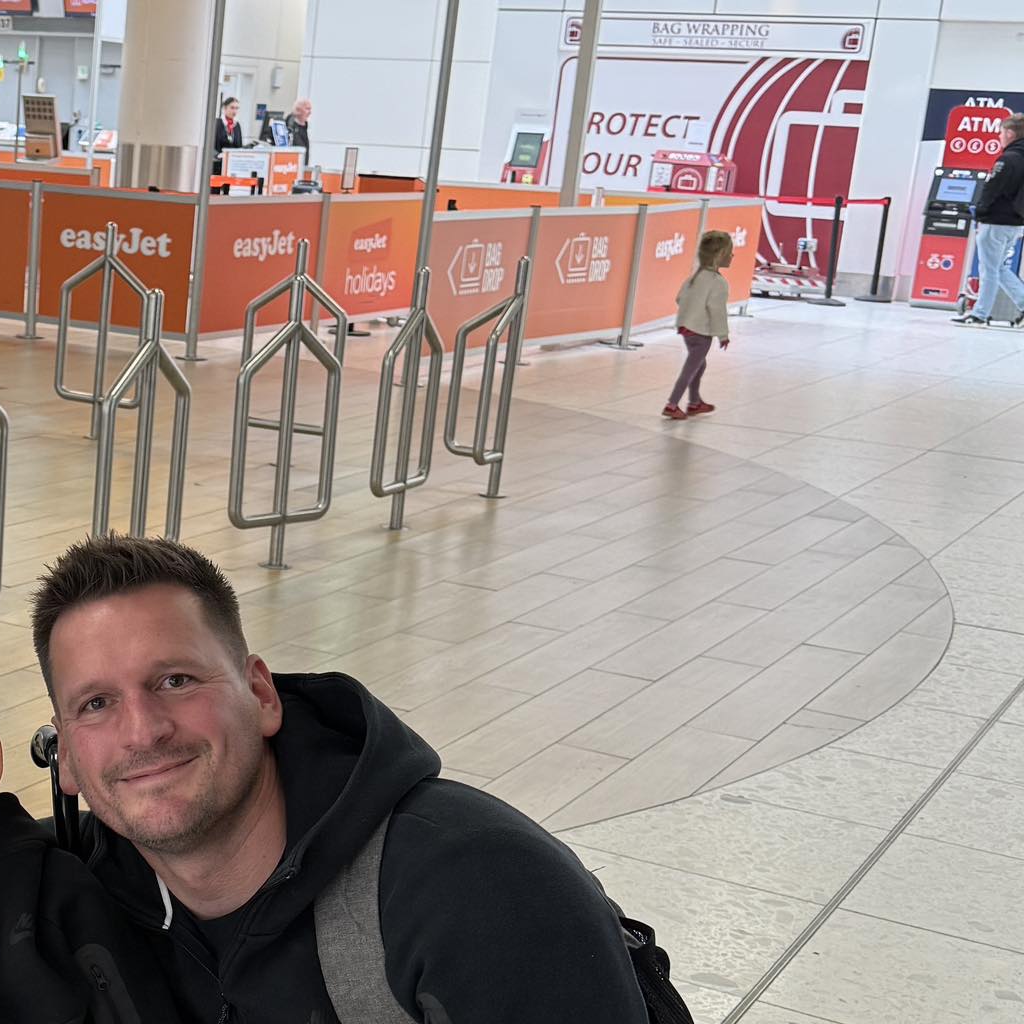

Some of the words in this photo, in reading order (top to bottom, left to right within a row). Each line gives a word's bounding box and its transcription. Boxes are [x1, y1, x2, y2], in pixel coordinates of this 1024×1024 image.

[652, 21, 681, 34] BAG
[687, 22, 770, 37] WRAPPING
[586, 111, 700, 139] ROTECT
[957, 116, 1002, 133] ATM
[582, 151, 642, 177] OUR
[232, 229, 295, 262] easyJet
[353, 233, 388, 253] easyJet
[485, 242, 503, 268] BAG
[591, 236, 609, 259] BAG
[344, 265, 397, 297] holidays
[481, 268, 504, 293] DROP
[588, 259, 611, 283] DROP
